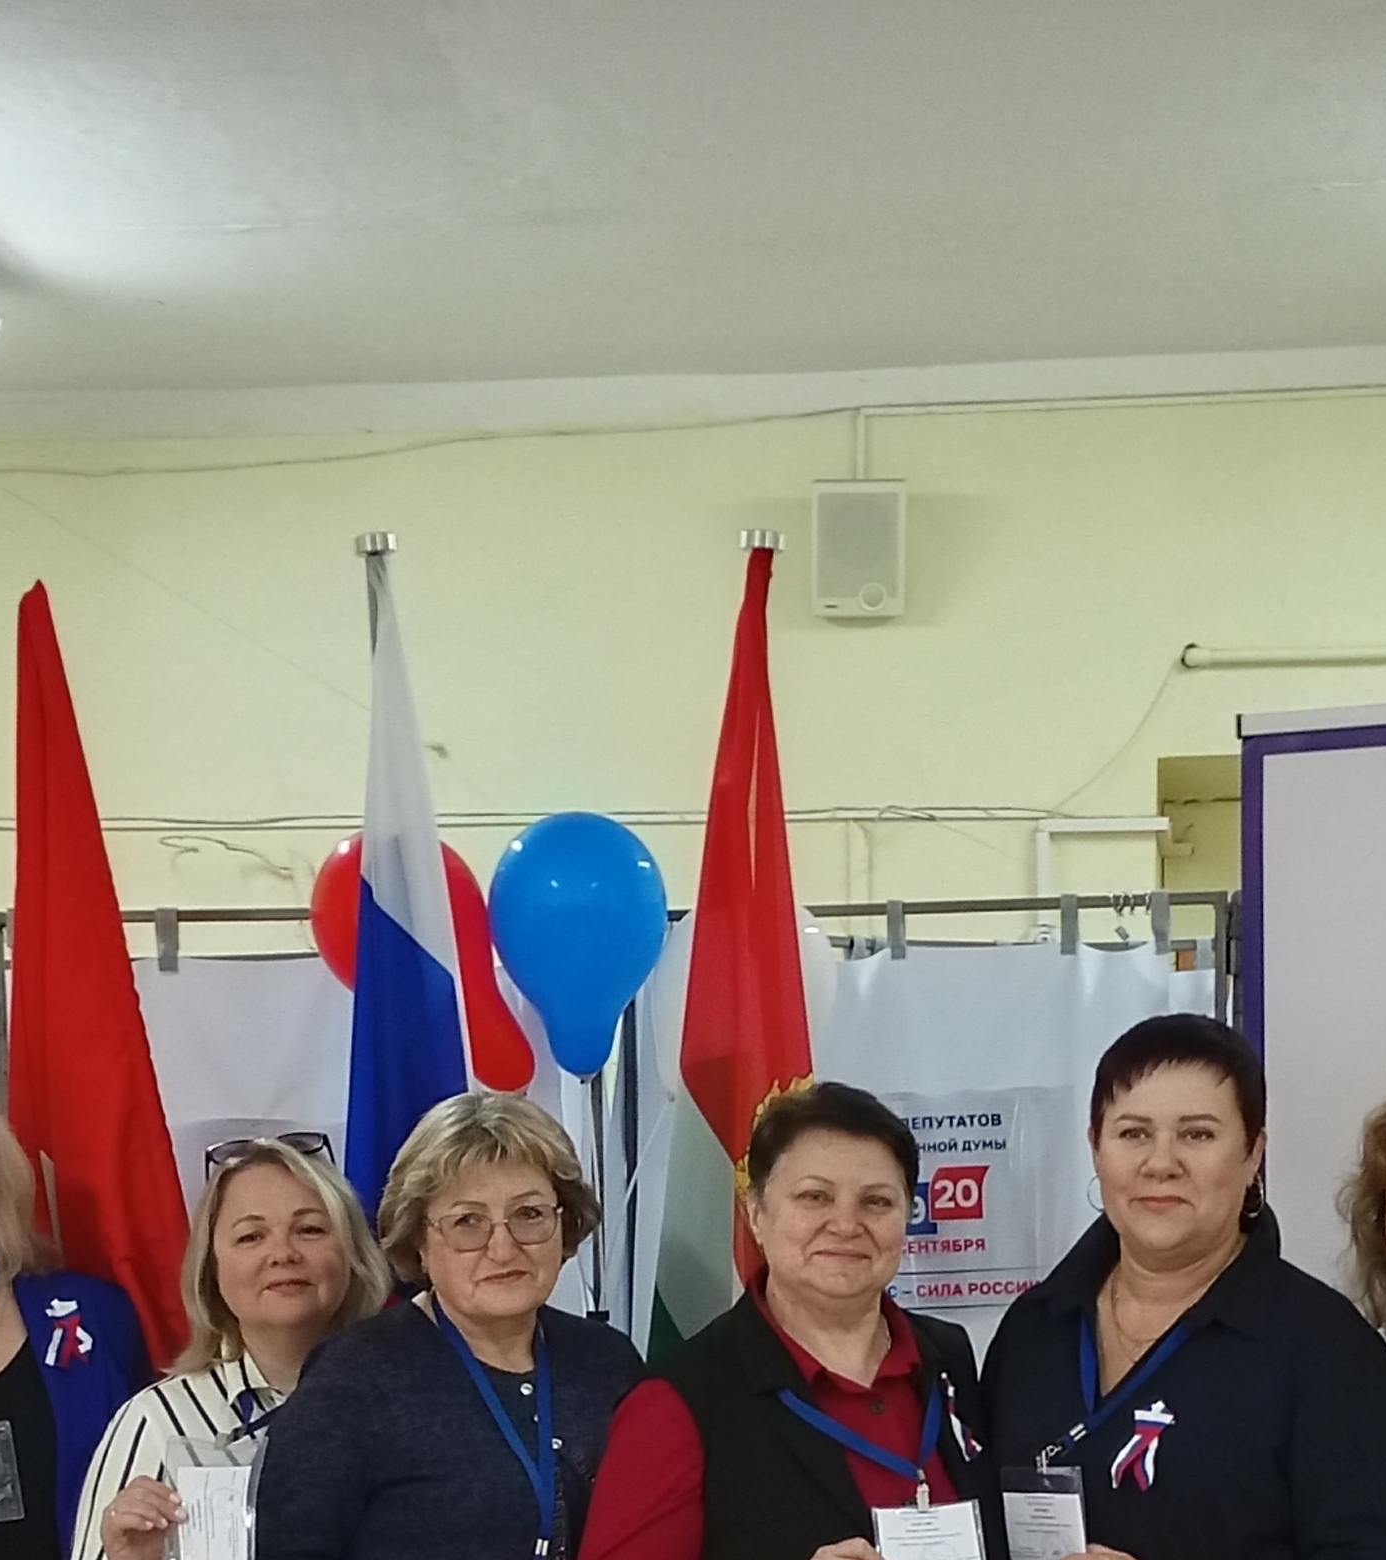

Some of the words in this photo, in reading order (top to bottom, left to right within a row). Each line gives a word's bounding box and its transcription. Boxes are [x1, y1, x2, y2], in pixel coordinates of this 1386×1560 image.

[962, 1138, 1007, 1152] ДУМЫ
[933, 1178, 979, 1209] 20
[902, 1238, 986, 1254] ЕНТЯБРЯ
[916, 1284, 963, 1298] СИЛА
